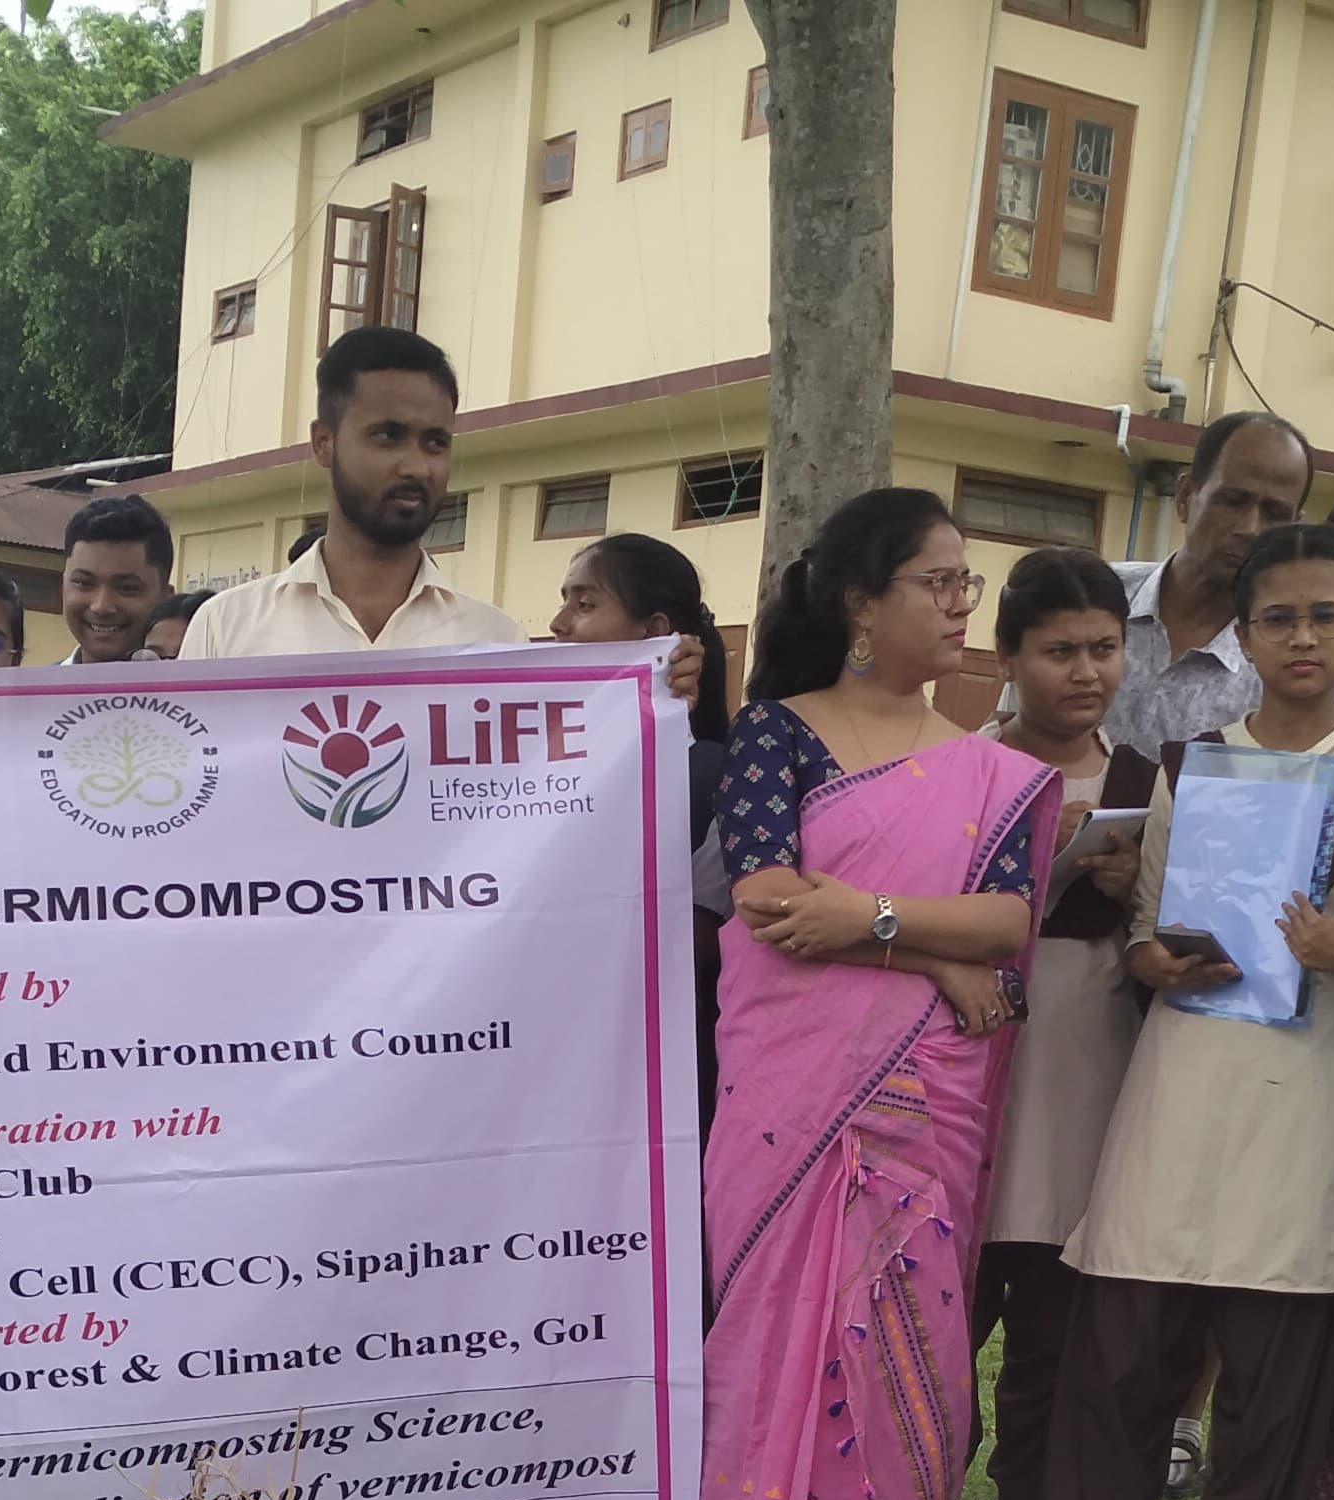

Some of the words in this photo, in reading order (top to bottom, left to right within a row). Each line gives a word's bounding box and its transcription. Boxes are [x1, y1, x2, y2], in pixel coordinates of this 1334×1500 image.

[46, 696, 208, 741] ENVIRONMENT
[428, 699, 587, 766] LiFE
[40, 769, 125, 839] EDUCATION
[132, 765, 219, 839] PROGRAMME
[430, 777, 536, 800] Lifestyle
[546, 774, 580, 792] for
[430, 795, 595, 822] Environment
[22, 971, 70, 1008] by
[44, 1033, 337, 1071] Environment
[352, 1021, 512, 1057] Council
[132, 1107, 220, 1138] with
[9, 1266, 98, 1297] Cell
[113, 1255, 302, 1299] (CECC),
[317, 1242, 490, 1283] Sipajhar
[504, 1230, 647, 1260] College
[82, 1312, 128, 1347] by
[122, 1355, 161, 1383] &
[178, 1343, 341, 1378] Climate
[356, 1330, 519, 1360] Change,
[534, 1314, 607, 1345] GoI
[366, 1407, 543, 1443] Science,
[337, 1450, 636, 1500] vermicompost
